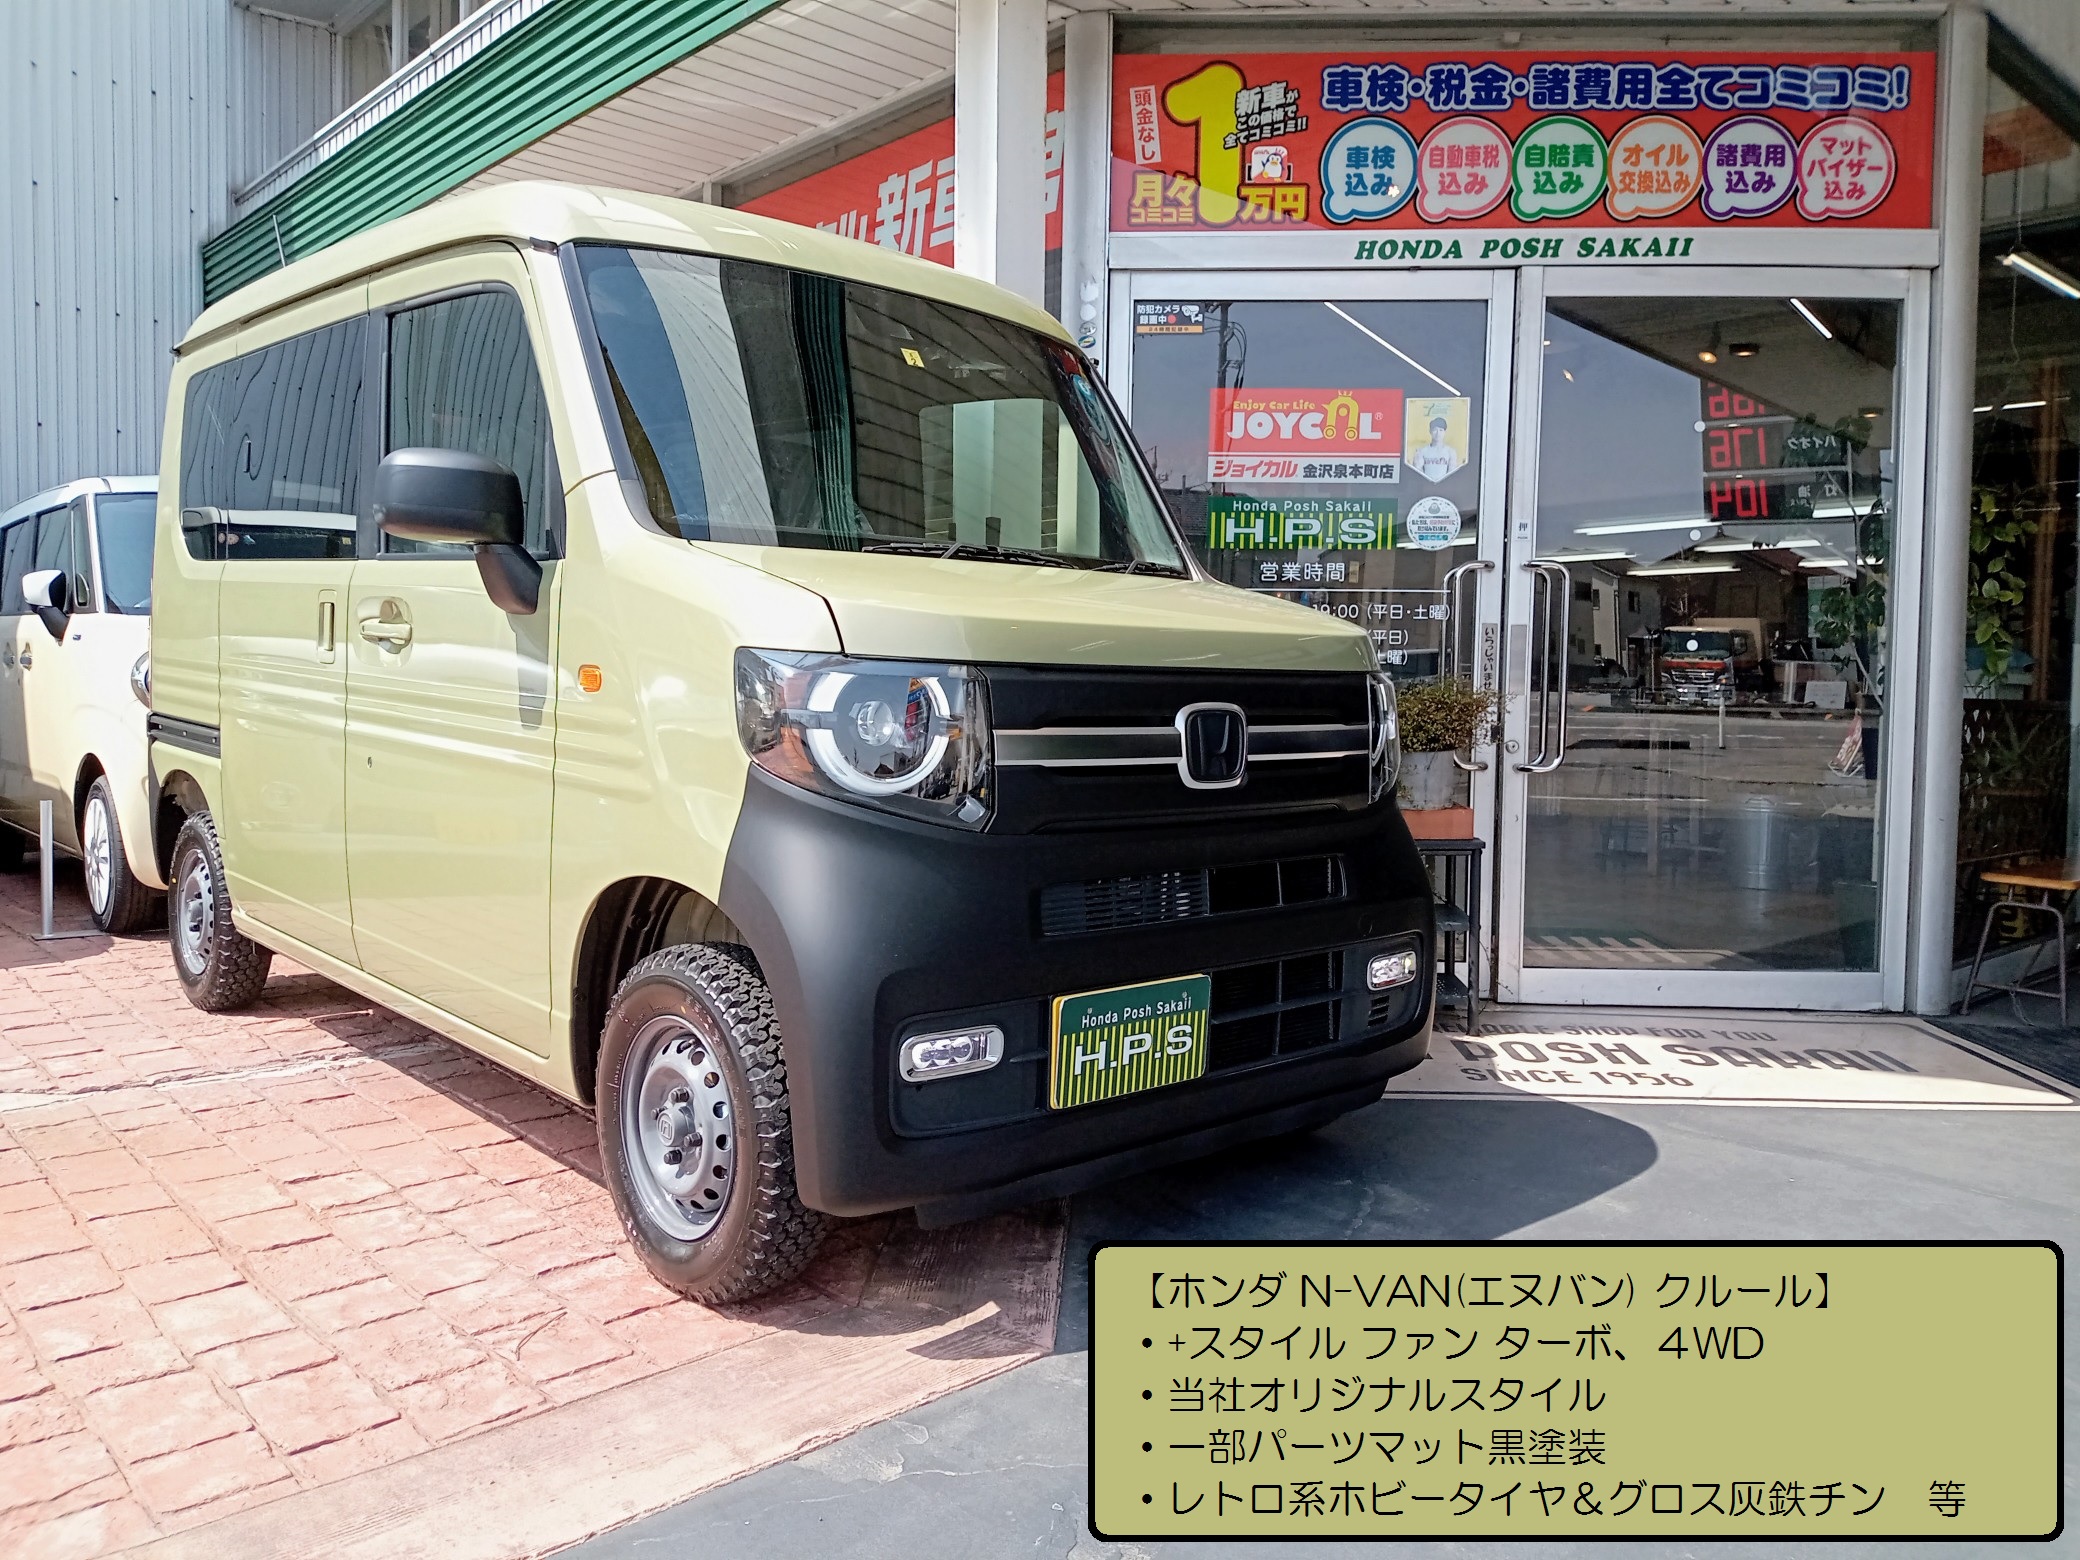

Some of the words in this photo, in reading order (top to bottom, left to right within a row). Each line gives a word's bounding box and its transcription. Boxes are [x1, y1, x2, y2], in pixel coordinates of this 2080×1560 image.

[1235, 81, 1299, 117] 新車が
[1134, 88, 1156, 161] 頭金なし
[1236, 104, 1297, 130] この価格で
[1428, 145, 1500, 168] 自動車税
[1524, 143, 1595, 168] 自賠責
[1622, 145, 1688, 167] オイル
[1716, 144, 1786, 167] 諸費用
[1821, 137, 1872, 153] マット
[1345, 146, 1395, 169] 車検
[1808, 159, 1882, 178] バイザー
[1133, 173, 1198, 207] 月々
[1345, 173, 1392, 196] 込み
[1438, 173, 1488, 195] 込み
[1533, 171, 1584, 194] 込み
[1618, 170, 1690, 194] 交換込み
[1726, 171, 1776, 194] 込み
[1824, 181, 1866, 200] 込み
[1131, 207, 1193, 223] コミコミ
[1240, 186, 1306, 221] 万円
[1354, 240, 1463, 260] HONDA
[1480, 238, 1564, 258] POSH
[1577, 237, 1695, 257] SAKAII
[1137, 304, 1180, 315] 防犯カメラ
[1139, 315, 1167, 325] 録画中
[1233, 400, 1265, 411] Enjoy
[1269, 401, 1289, 410] Car
[1293, 400, 1315, 410] Life
[1213, 459, 1298, 478] ジョイカル
[1302, 463, 1394, 479] 金沢泉本町店
[1233, 501, 1276, 512] Honda
[1284, 501, 1318, 512] Posh
[1226, 518, 1377, 544] H.P.S
[1260, 562, 1346, 582] 営業時間
[1483, 626, 1495, 691] いらっしゃいませ
[1081, 1011, 1118, 1029] Honda
[1123, 1004, 1151, 1021] Posh
[1562, 1025, 1641, 1037] SHOP
[1645, 1027, 1708, 1040] FOR
[1710, 1030, 1778, 1042] YOU
[1074, 1024, 1193, 1076] H.P.S
[1450, 1041, 1651, 1066] POSH
[1460, 1067, 1583, 1085] SINCE
[1589, 1070, 1695, 1088] 1956
